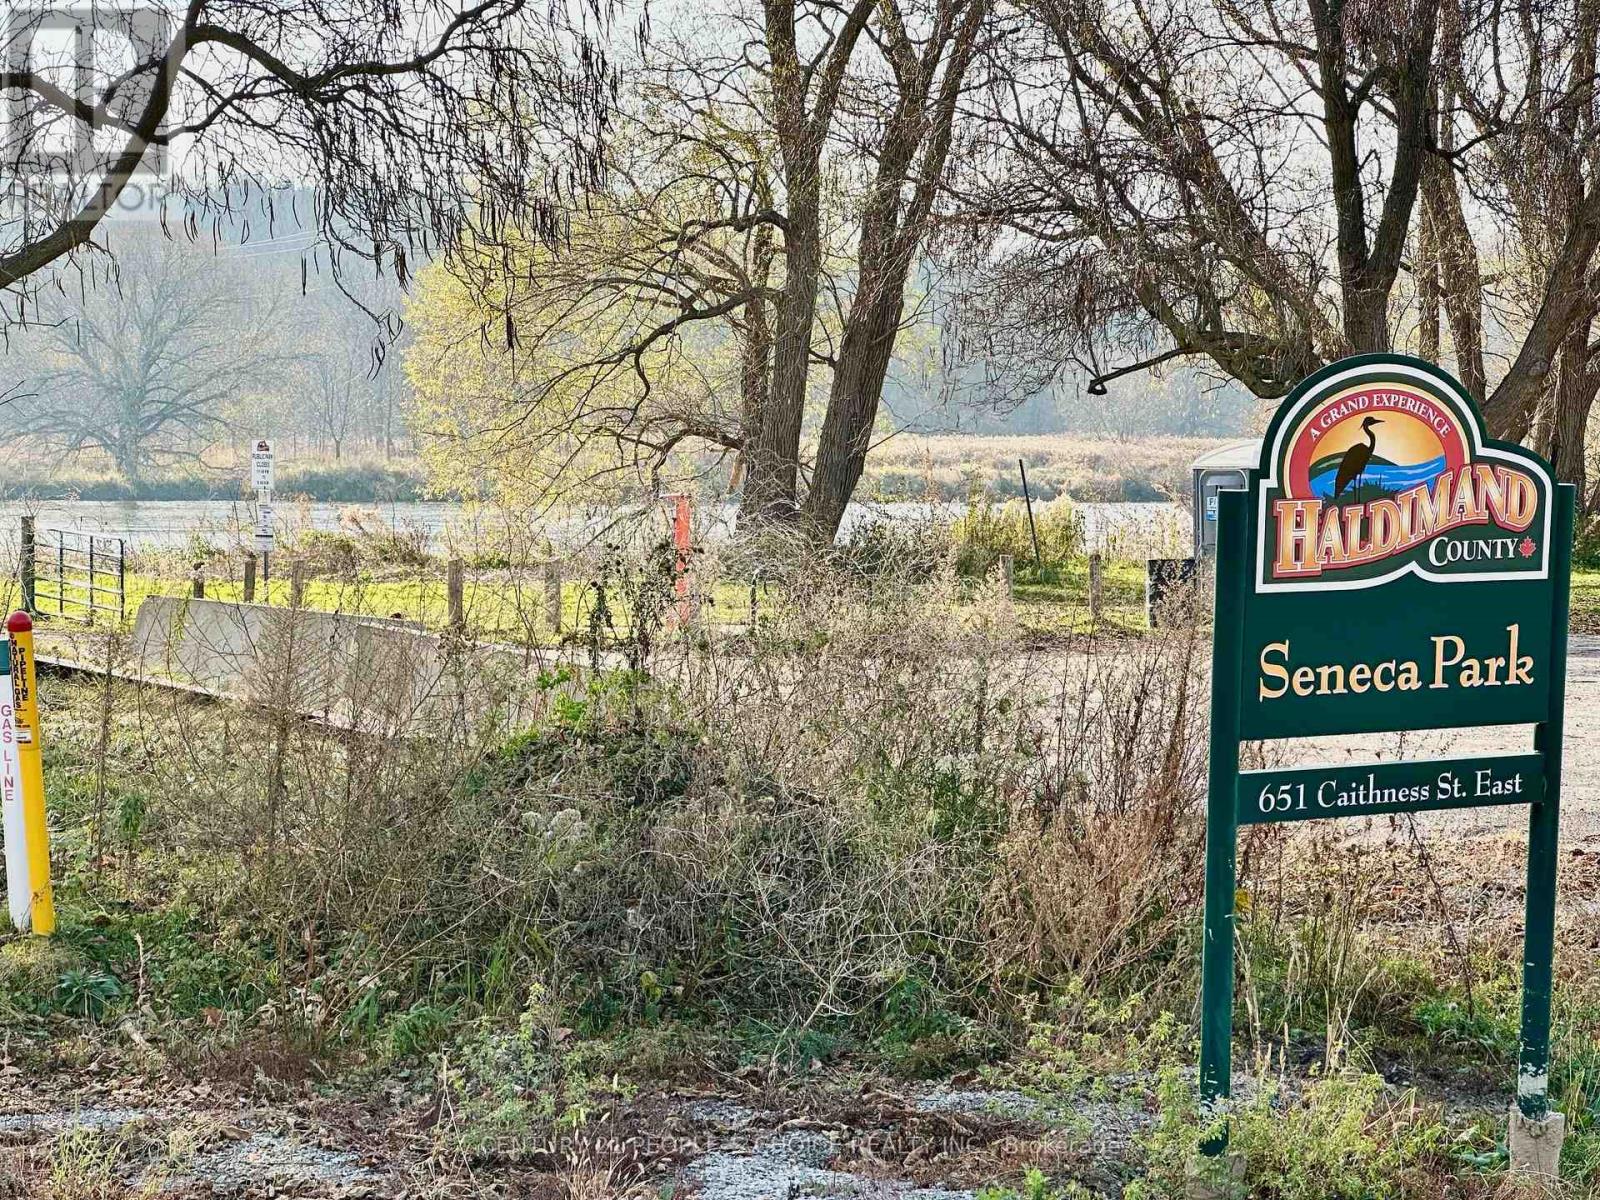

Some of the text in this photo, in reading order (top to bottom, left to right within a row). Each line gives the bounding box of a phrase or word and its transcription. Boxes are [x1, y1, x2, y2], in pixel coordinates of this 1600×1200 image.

[1308, 393, 1453, 442] A GRAND EXPERIENCE
[1272, 463, 1538, 579] HALDIMAND
[1428, 536, 1519, 567] COUNTY
[18, 647, 29, 702] PIPELINE
[1258, 623, 1535, 703] Seneca Park
[1, 704, 14, 801] GAS LINE
[1258, 768, 1523, 813] 651 Caithness St. East
